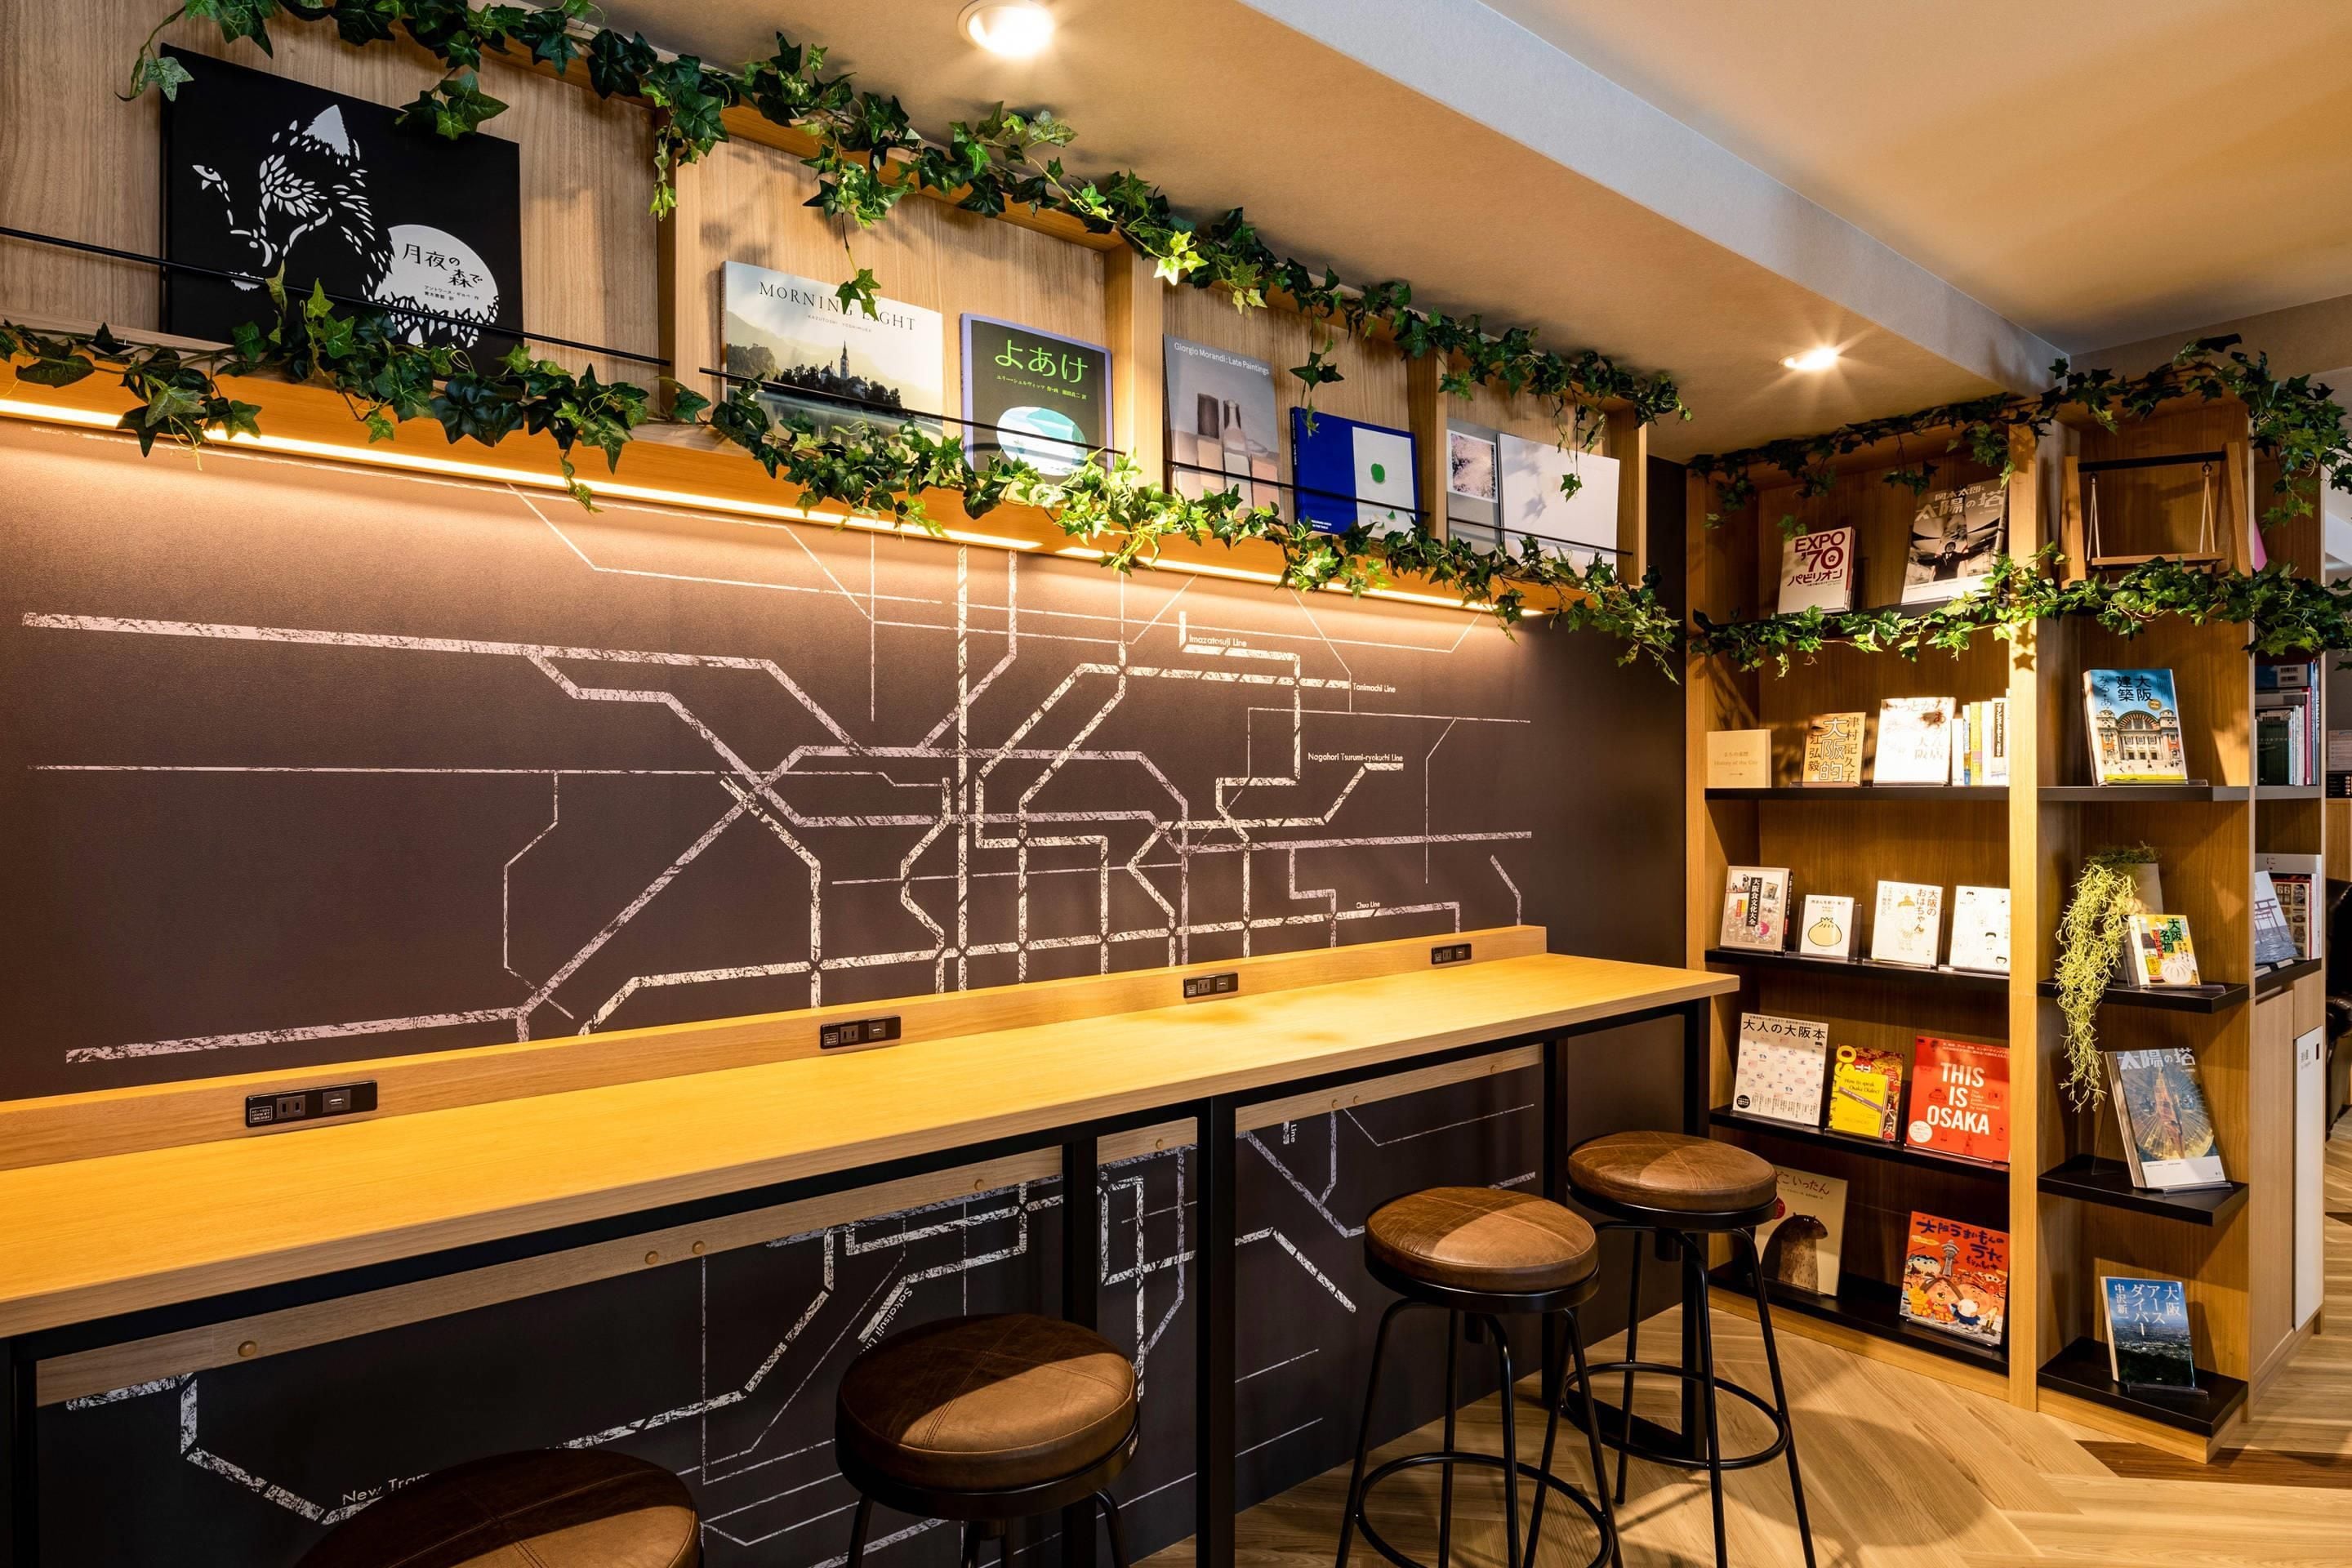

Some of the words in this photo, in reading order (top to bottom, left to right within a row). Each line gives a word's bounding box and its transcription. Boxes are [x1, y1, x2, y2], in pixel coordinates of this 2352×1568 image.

[403, 243, 461, 272] 月夜の
[448, 269, 483, 288] 森で
[862, 306, 915, 331] LGHT
[995, 339, 1089, 383] よあけ
[1174, 342, 1199, 356] Giorgio
[1199, 349, 1228, 363] Morandi:
[1228, 356, 1242, 368] Late
[1242, 360, 1270, 376] Paintings
[1914, 489, 2007, 523] 太陽の塔
[1794, 531, 1846, 553] EXPO
[1786, 568, 1843, 587] パビリオン
[1189, 634, 1231, 648] Imazatosuji
[1232, 638, 1247, 648] Line
[1352, 682, 1383, 693] Tanimachi
[1383, 684, 1396, 693] Line
[2116, 675, 2135, 702] 建築
[2135, 675, 2154, 702] 大阪
[1307, 751, 1339, 763] Nagahori
[1340, 752, 1390, 763] Tsurumi-ryokuchi
[1391, 753, 1403, 762] Line
[1807, 734, 1823, 773] 江弘毅
[1819, 718, 1848, 782] 大阪的
[1842, 716, 1860, 783] 津村記久子
[1748, 878, 1761, 926] 大阪食文化大全
[1927, 889, 1939, 916] 大阪の
[2167, 918, 2183, 942] 大阪
[1743, 1018, 1826, 1040] 大人の大阪本
[2117, 1047, 2196, 1071] 太陽の塔
[1940, 1062, 1984, 1088] THIS
[1949, 1085, 1968, 1108] IS
[1927, 1105, 1990, 1135] OSAKA
[1916, 1219, 2005, 1245] 大阪うまいもんの
[875, 1287, 914, 1337] Sakaisuji
[2114, 1283, 2130, 1319] 中沢新一
[2131, 1283, 2149, 1336] ダイバー
[2147, 1285, 2166, 1325] アース
[2163, 1285, 2181, 1316] 大阪
[342, 1486, 382, 1506] New
